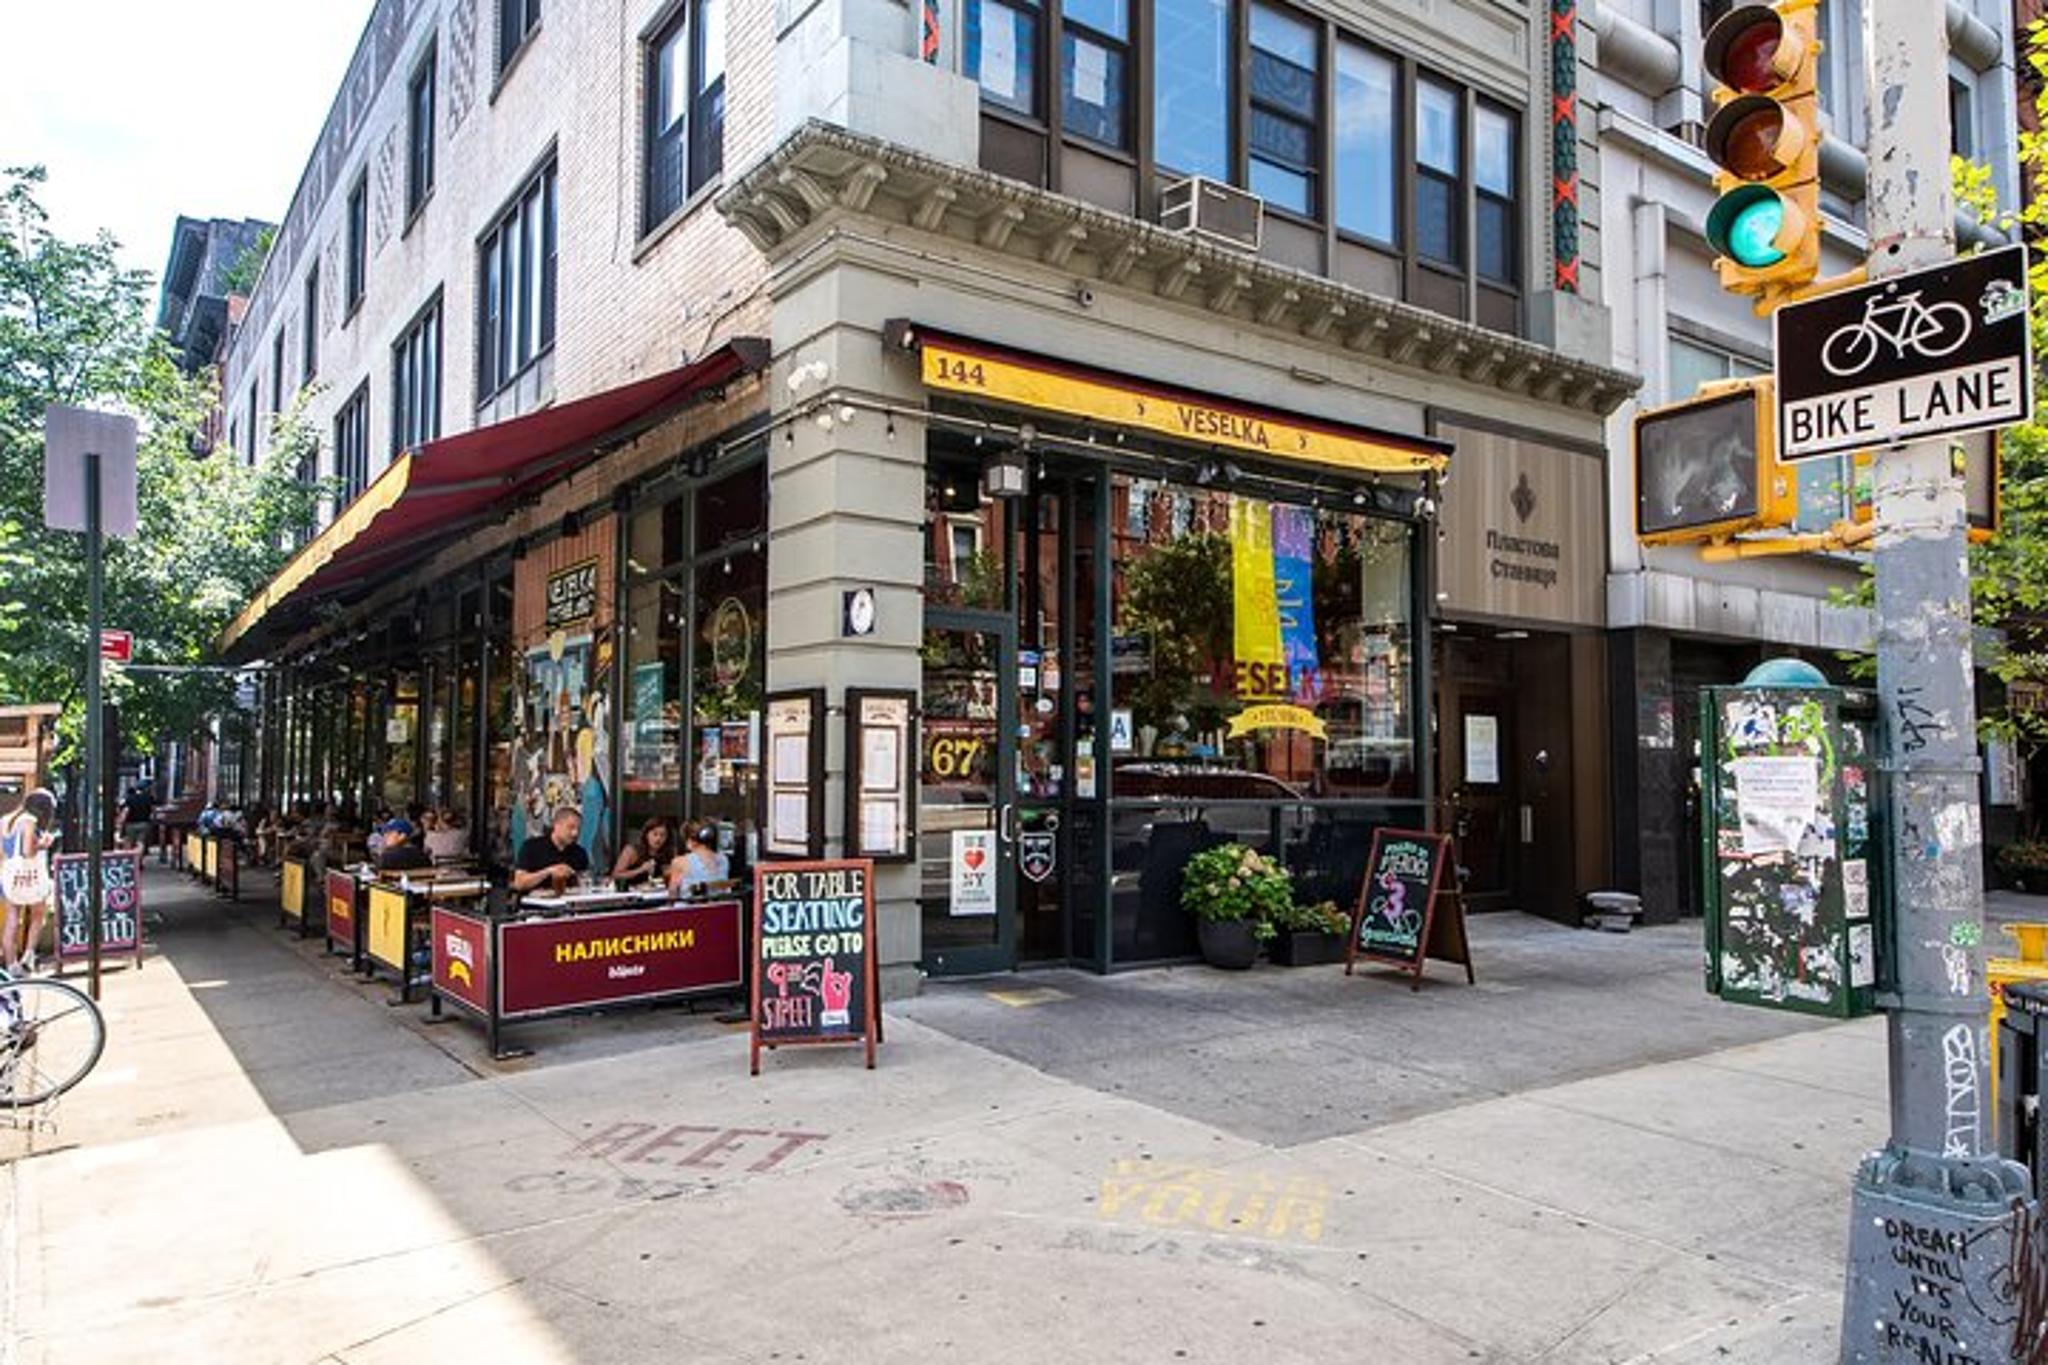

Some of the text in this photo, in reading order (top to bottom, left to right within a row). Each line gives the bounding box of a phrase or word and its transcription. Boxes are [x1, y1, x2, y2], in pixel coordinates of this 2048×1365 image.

[937, 357, 985, 387] 144
[1791, 366, 2011, 444] BIKE LANE
[1177, 405, 1270, 450] VESELKA
[1115, 717, 1127, 739] A
[931, 738, 979, 777] 67
[763, 870, 864, 902] FOR TABLE
[763, 899, 864, 935] SEATING
[555, 929, 694, 964] НАЛИСНИКИ
[762, 931, 863, 960] PLEASE GO TO
[1892, 1245, 1963, 1284] UNTIL
[1911, 1274, 1952, 1310] ITS
[1893, 1289, 1958, 1344] YOUR
